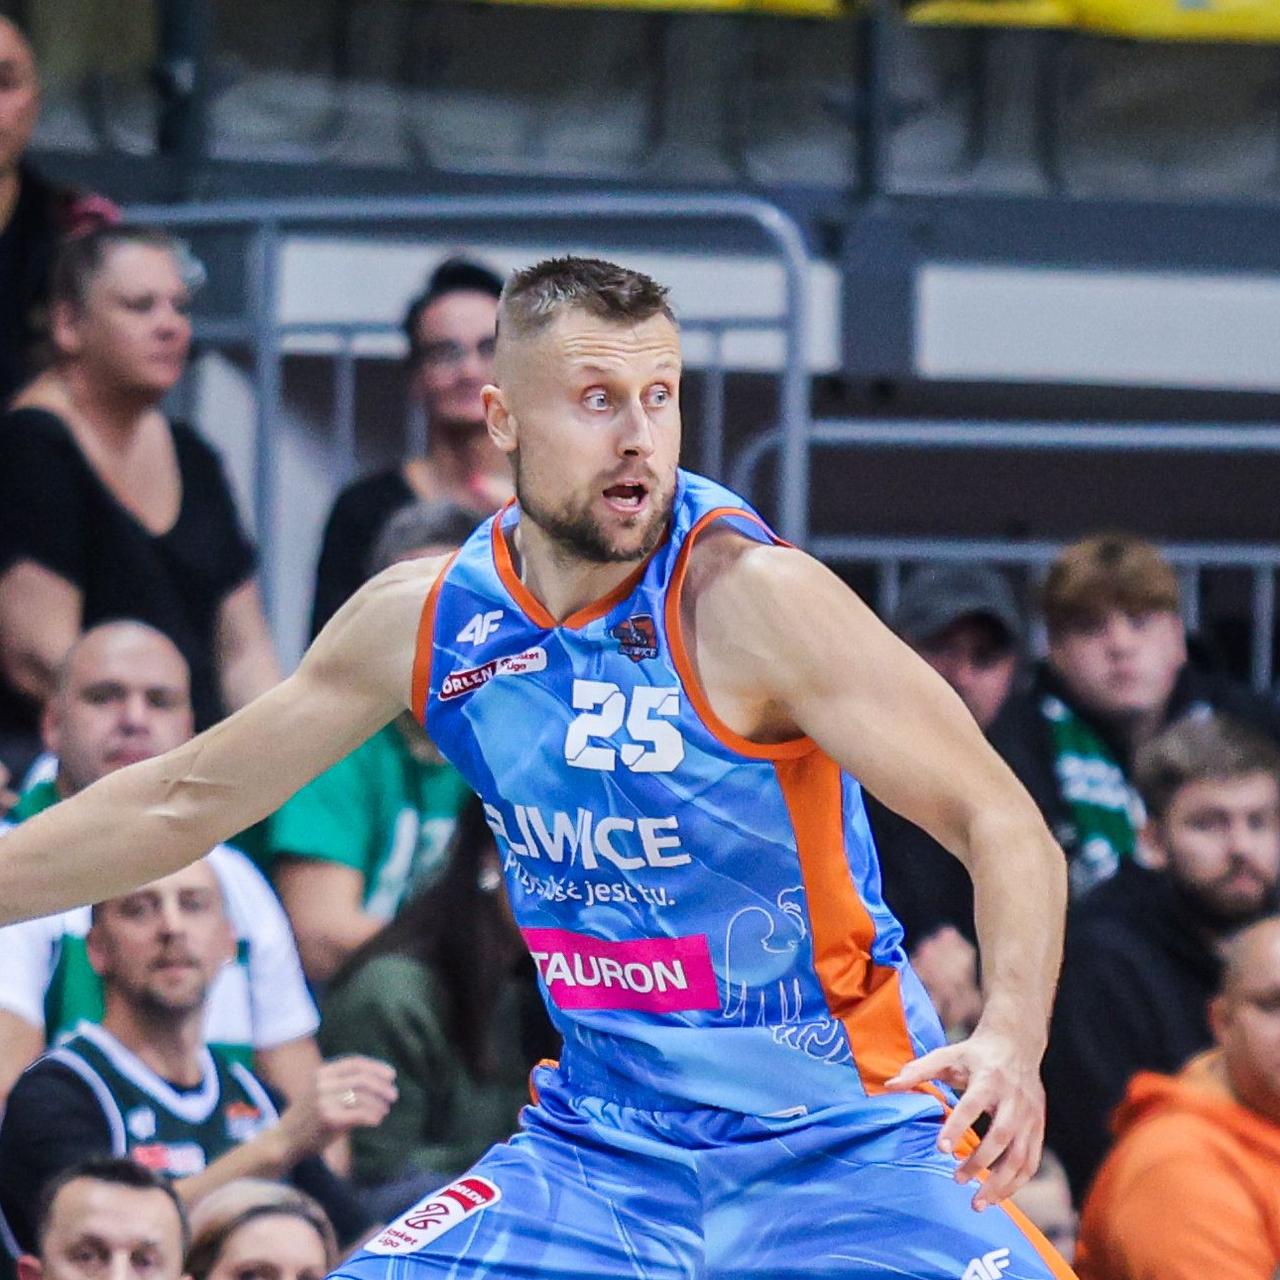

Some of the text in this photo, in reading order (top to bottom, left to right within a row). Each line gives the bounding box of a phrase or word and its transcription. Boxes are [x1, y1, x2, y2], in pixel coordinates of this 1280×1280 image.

[456, 610, 504, 646] 4F
[442, 664, 495, 695] ORLEN
[565, 679, 686, 773] 25
[584, 879, 637, 907] jest
[530, 951, 688, 994] TAURON
